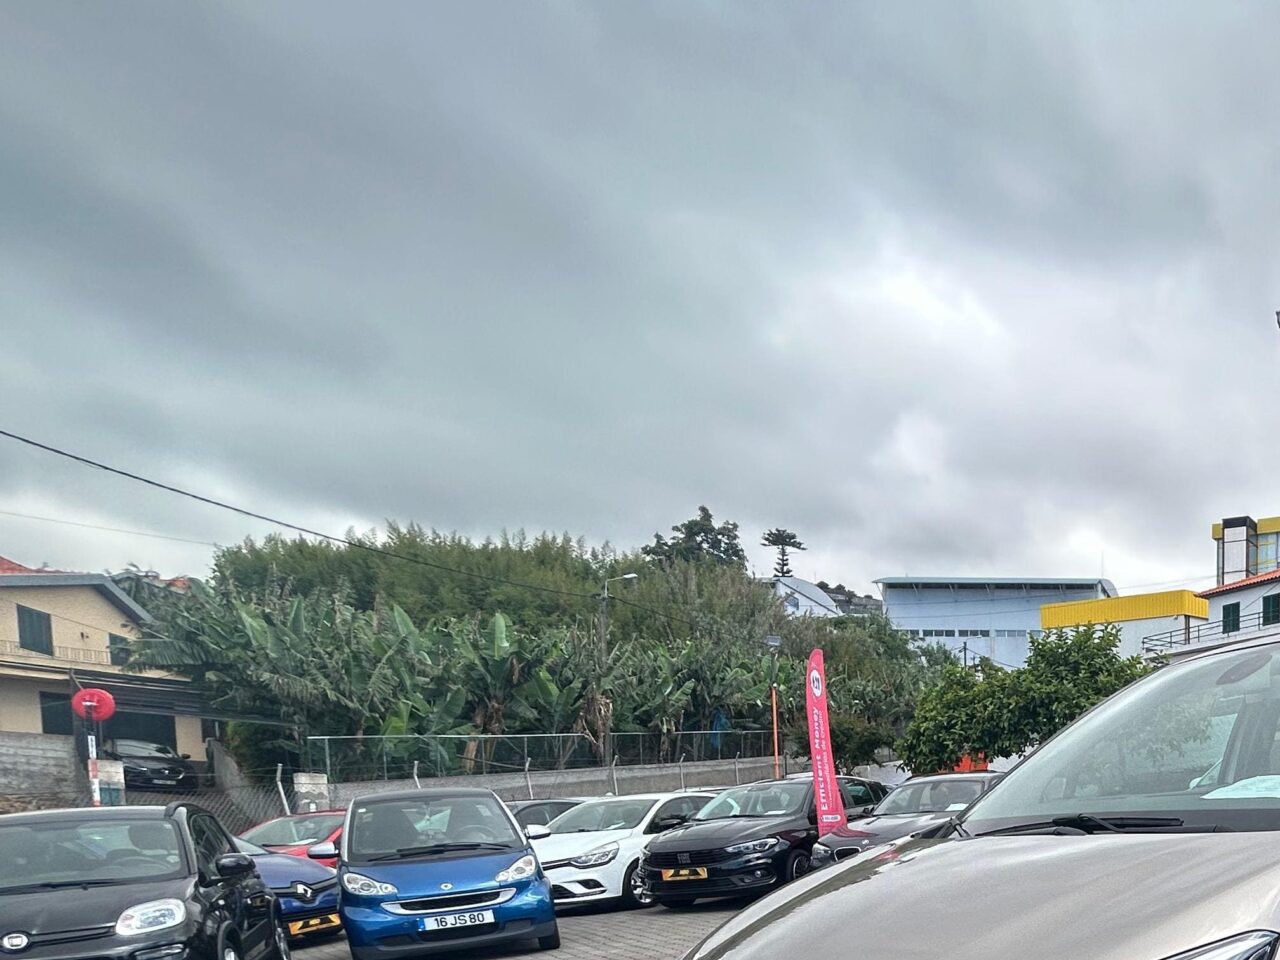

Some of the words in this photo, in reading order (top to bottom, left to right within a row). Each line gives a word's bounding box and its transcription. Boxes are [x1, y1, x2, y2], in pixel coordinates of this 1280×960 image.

[813, 706, 821, 749] Money
[434, 916, 448, 929] 16
[450, 915, 468, 927] JS
[469, 912, 485, 924] 80
